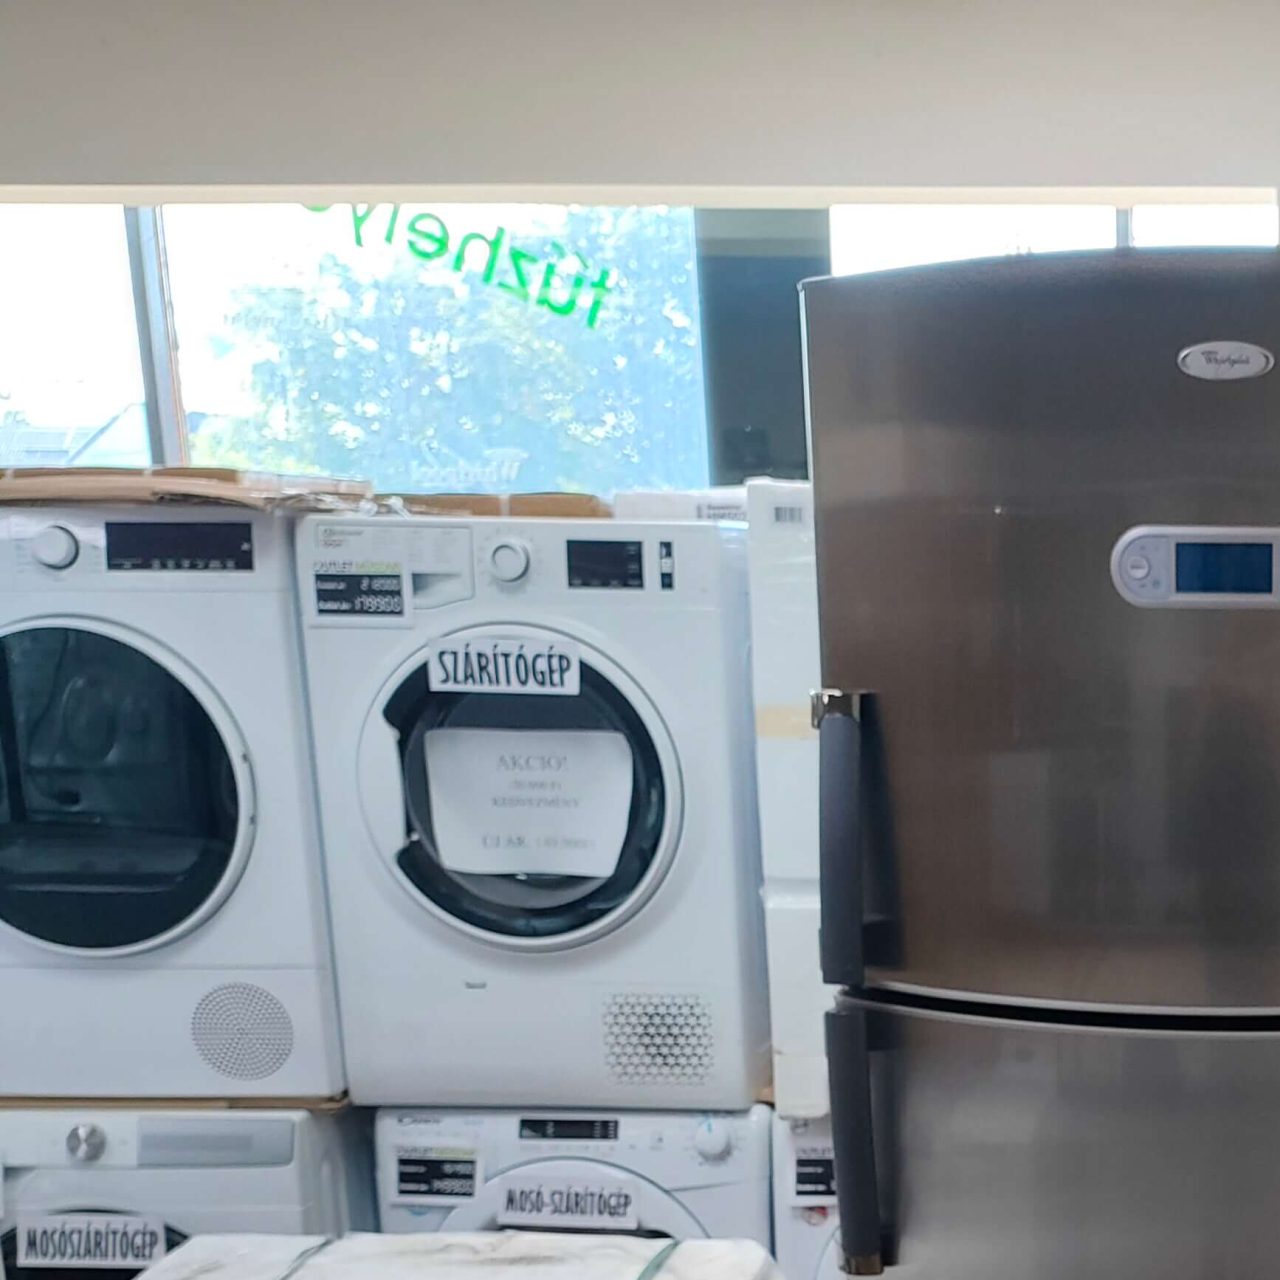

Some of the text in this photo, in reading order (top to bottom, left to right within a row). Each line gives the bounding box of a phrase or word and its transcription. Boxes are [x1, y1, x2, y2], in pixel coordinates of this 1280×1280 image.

[1201, 351, 1250, 367] Whirlpool
[438, 643, 571, 687] SZÁRÍTÓGÉP
[505, 1184, 632, 1218] MOSÓ-SZÁRÍTÓGÉP
[25, 1221, 159, 1261] MOSÓSZÁRÍTÓGÉP
